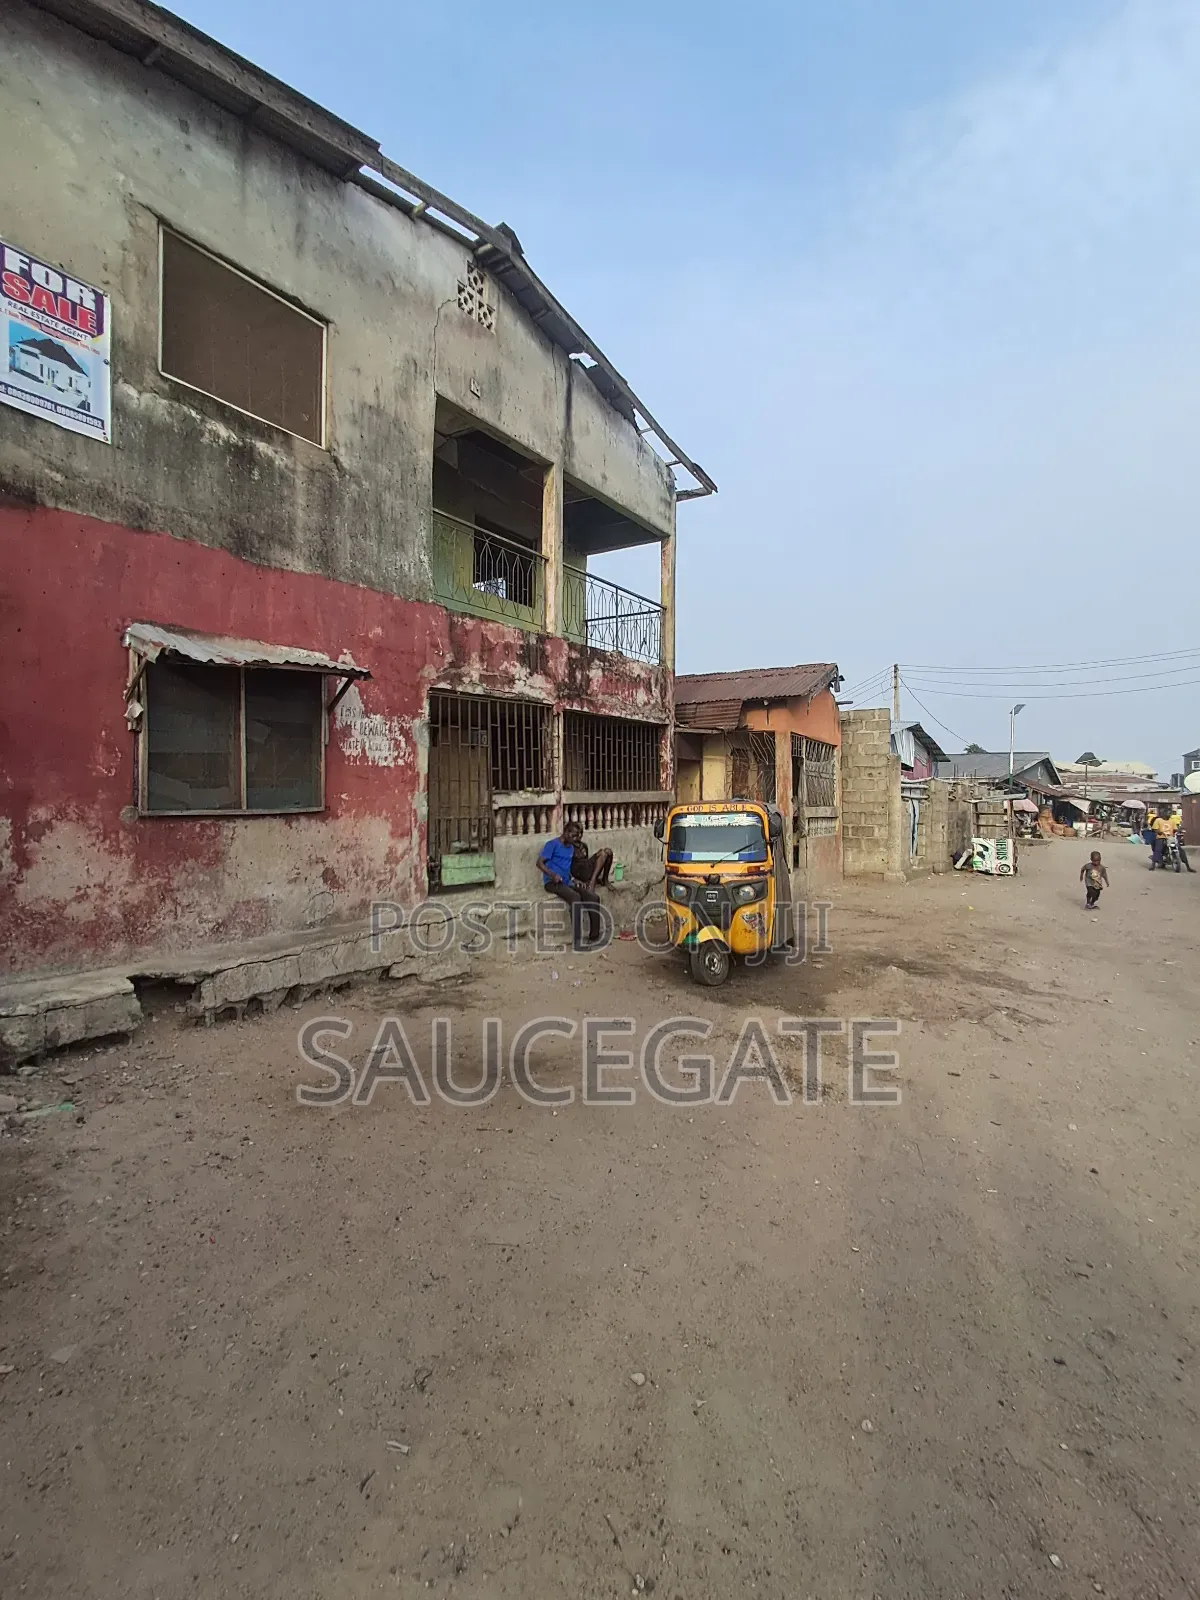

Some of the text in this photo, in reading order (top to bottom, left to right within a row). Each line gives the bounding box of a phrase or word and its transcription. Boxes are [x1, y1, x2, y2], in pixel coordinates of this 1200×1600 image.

[2, 271, 97, 336] SALE
[4, 246, 96, 311] FOR
[7, 300, 29, 315] REAL
[31, 312, 59, 329] ESTATE
[61, 326, 89, 341] AGENT
[686, 803, 747, 813] GOD IS ABLE
